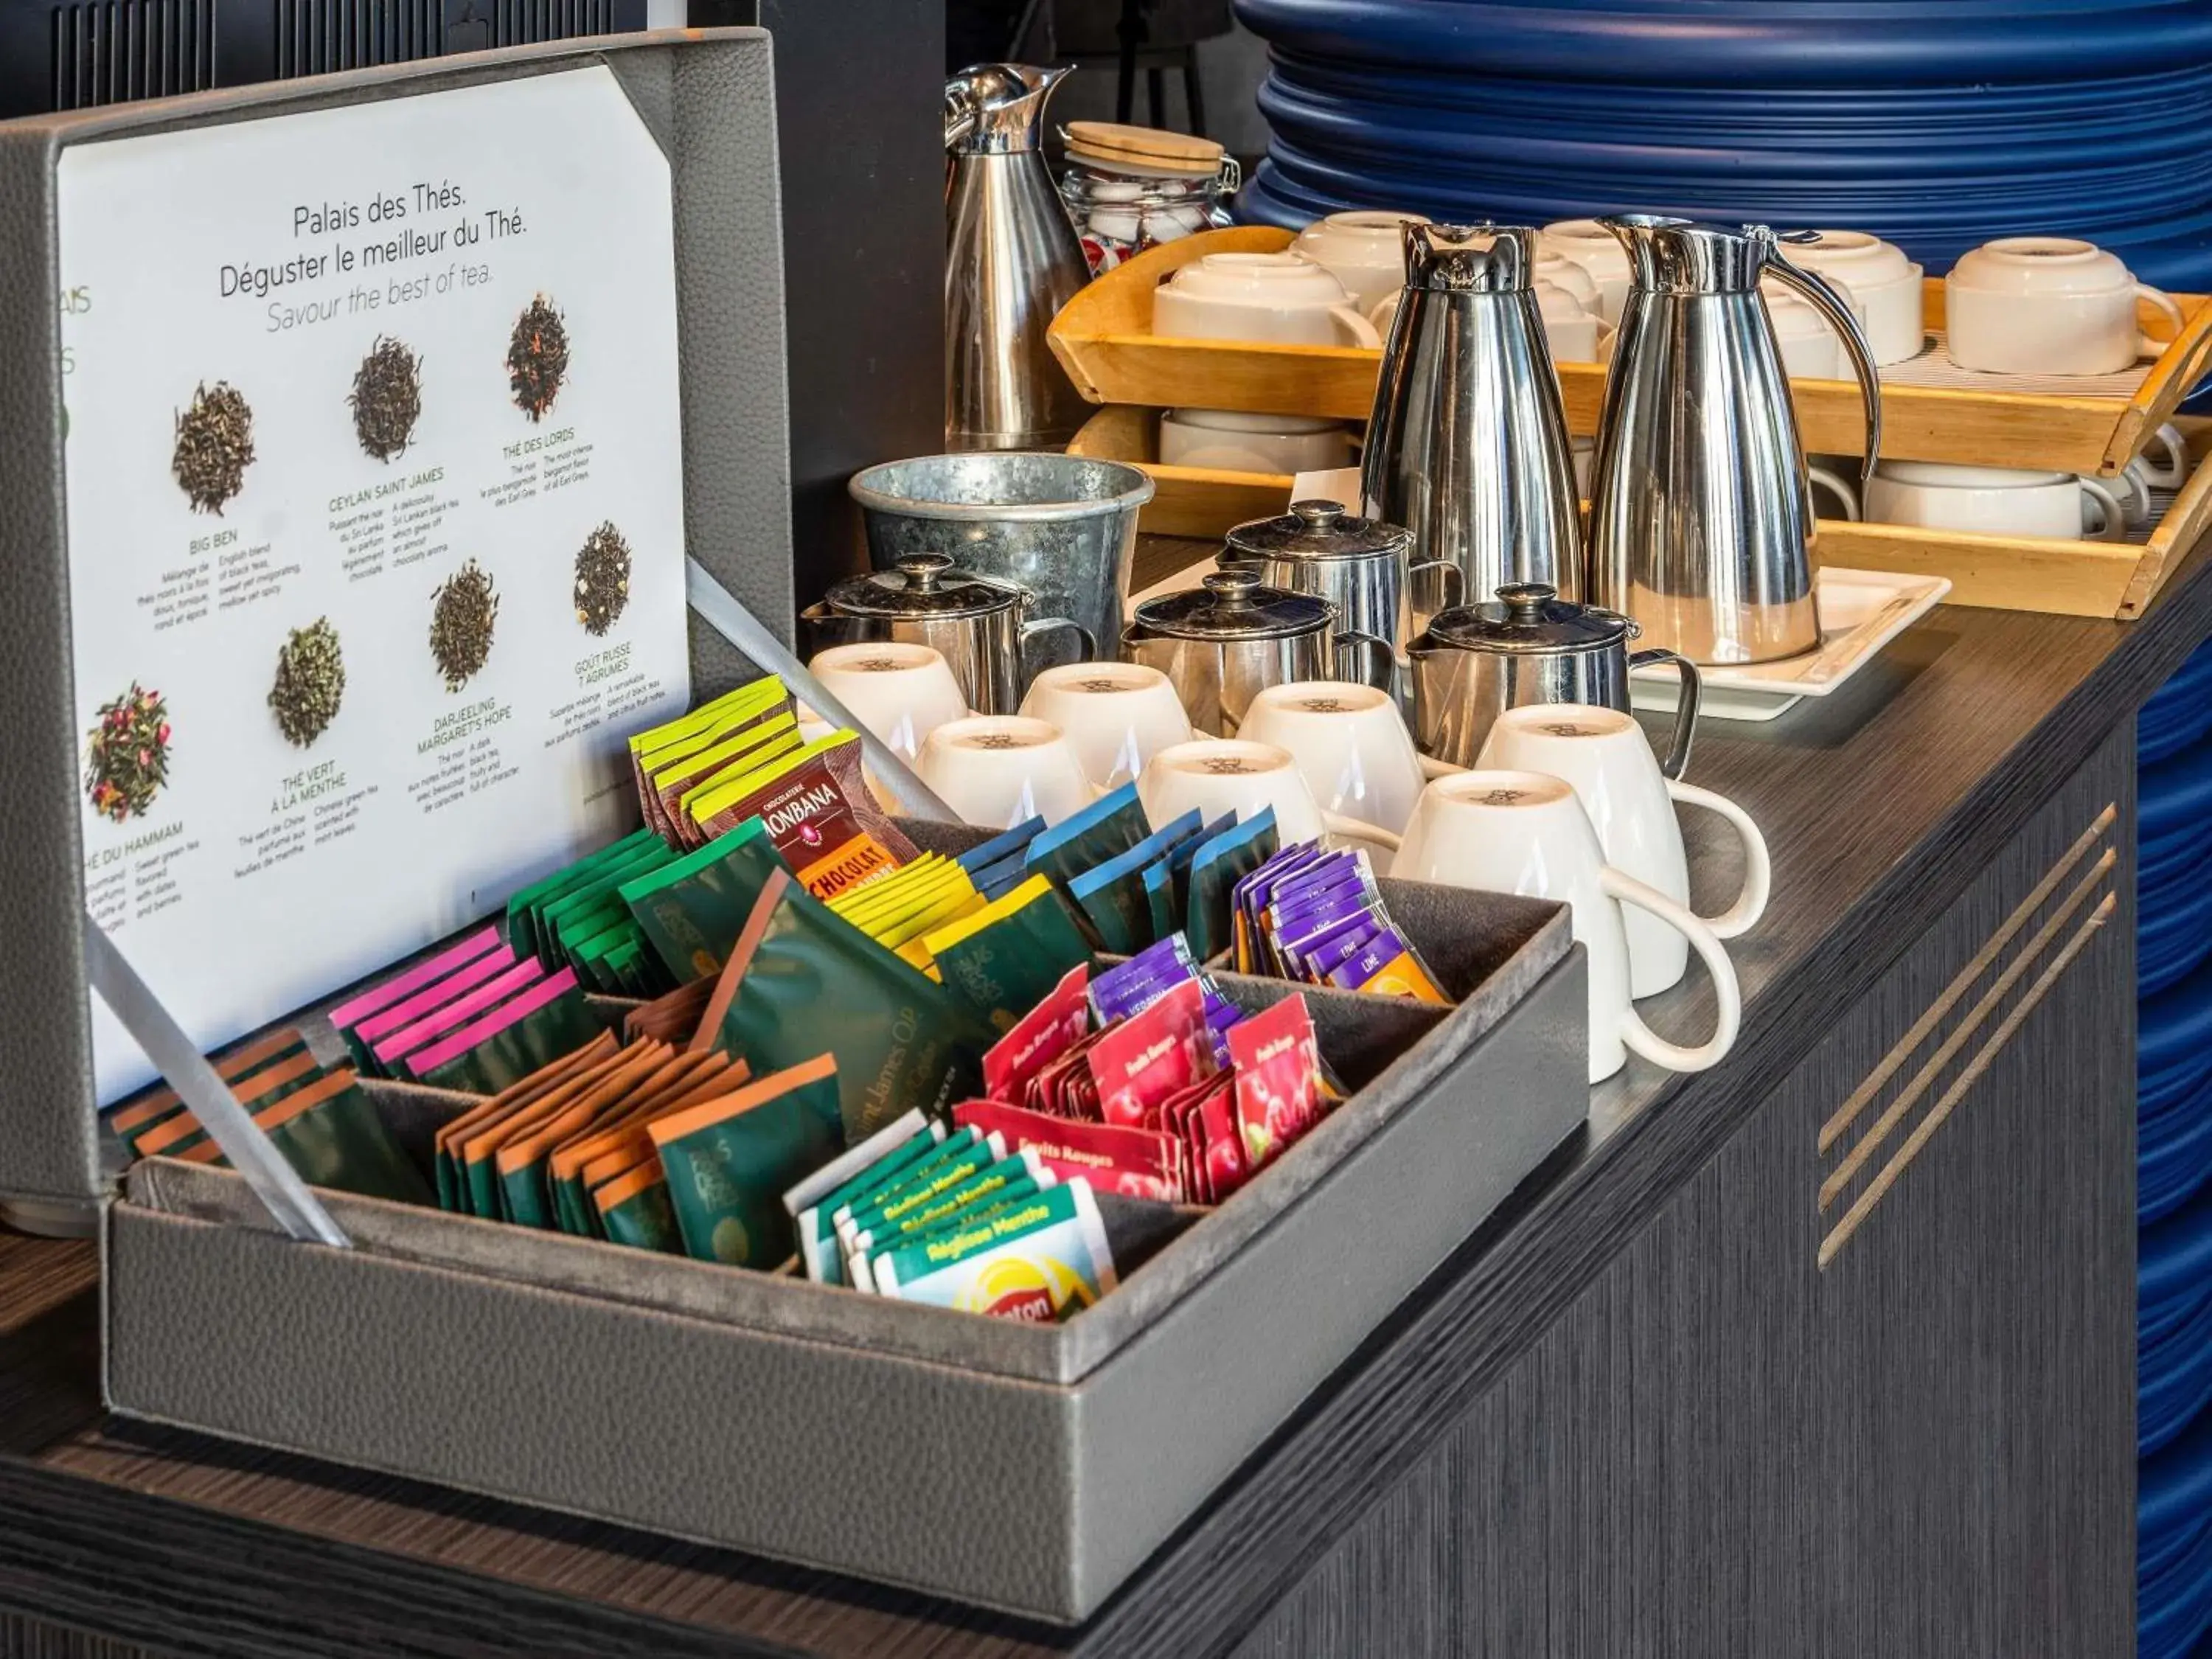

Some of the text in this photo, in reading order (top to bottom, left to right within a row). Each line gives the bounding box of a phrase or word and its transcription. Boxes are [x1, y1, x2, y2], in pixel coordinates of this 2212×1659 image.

[294, 179, 466, 237] Palais des Thés.
[220, 206, 527, 297] Déguster le meilleur du Thé.
[266, 261, 494, 333] Savour the best of tea.
[524, 437, 543, 454] DES
[545, 426, 575, 448] LORDS
[329, 488, 372, 513] CEYLAN
[375, 477, 406, 501] SAINT
[409, 466, 445, 490] JAMES
[189, 529, 238, 555] BIG BEN
[585, 658, 630, 685] AGRUMES
[602, 641, 631, 664] RUSSE
[417, 717, 482, 755] MARGARET'S
[484, 704, 513, 728] HOPE
[434, 696, 495, 733] DARJEELING
[306, 759, 335, 782] VERT
[282, 793, 297, 810] LA
[299, 771, 347, 802] MENTHE
[102, 846, 122, 866] DU
[125, 820, 184, 857] HAMMAM
[809, 846, 885, 902] CHOCOLAT
[1062, 1144, 1114, 1169] Rouges
[991, 1204, 1050, 1237] Menthe
